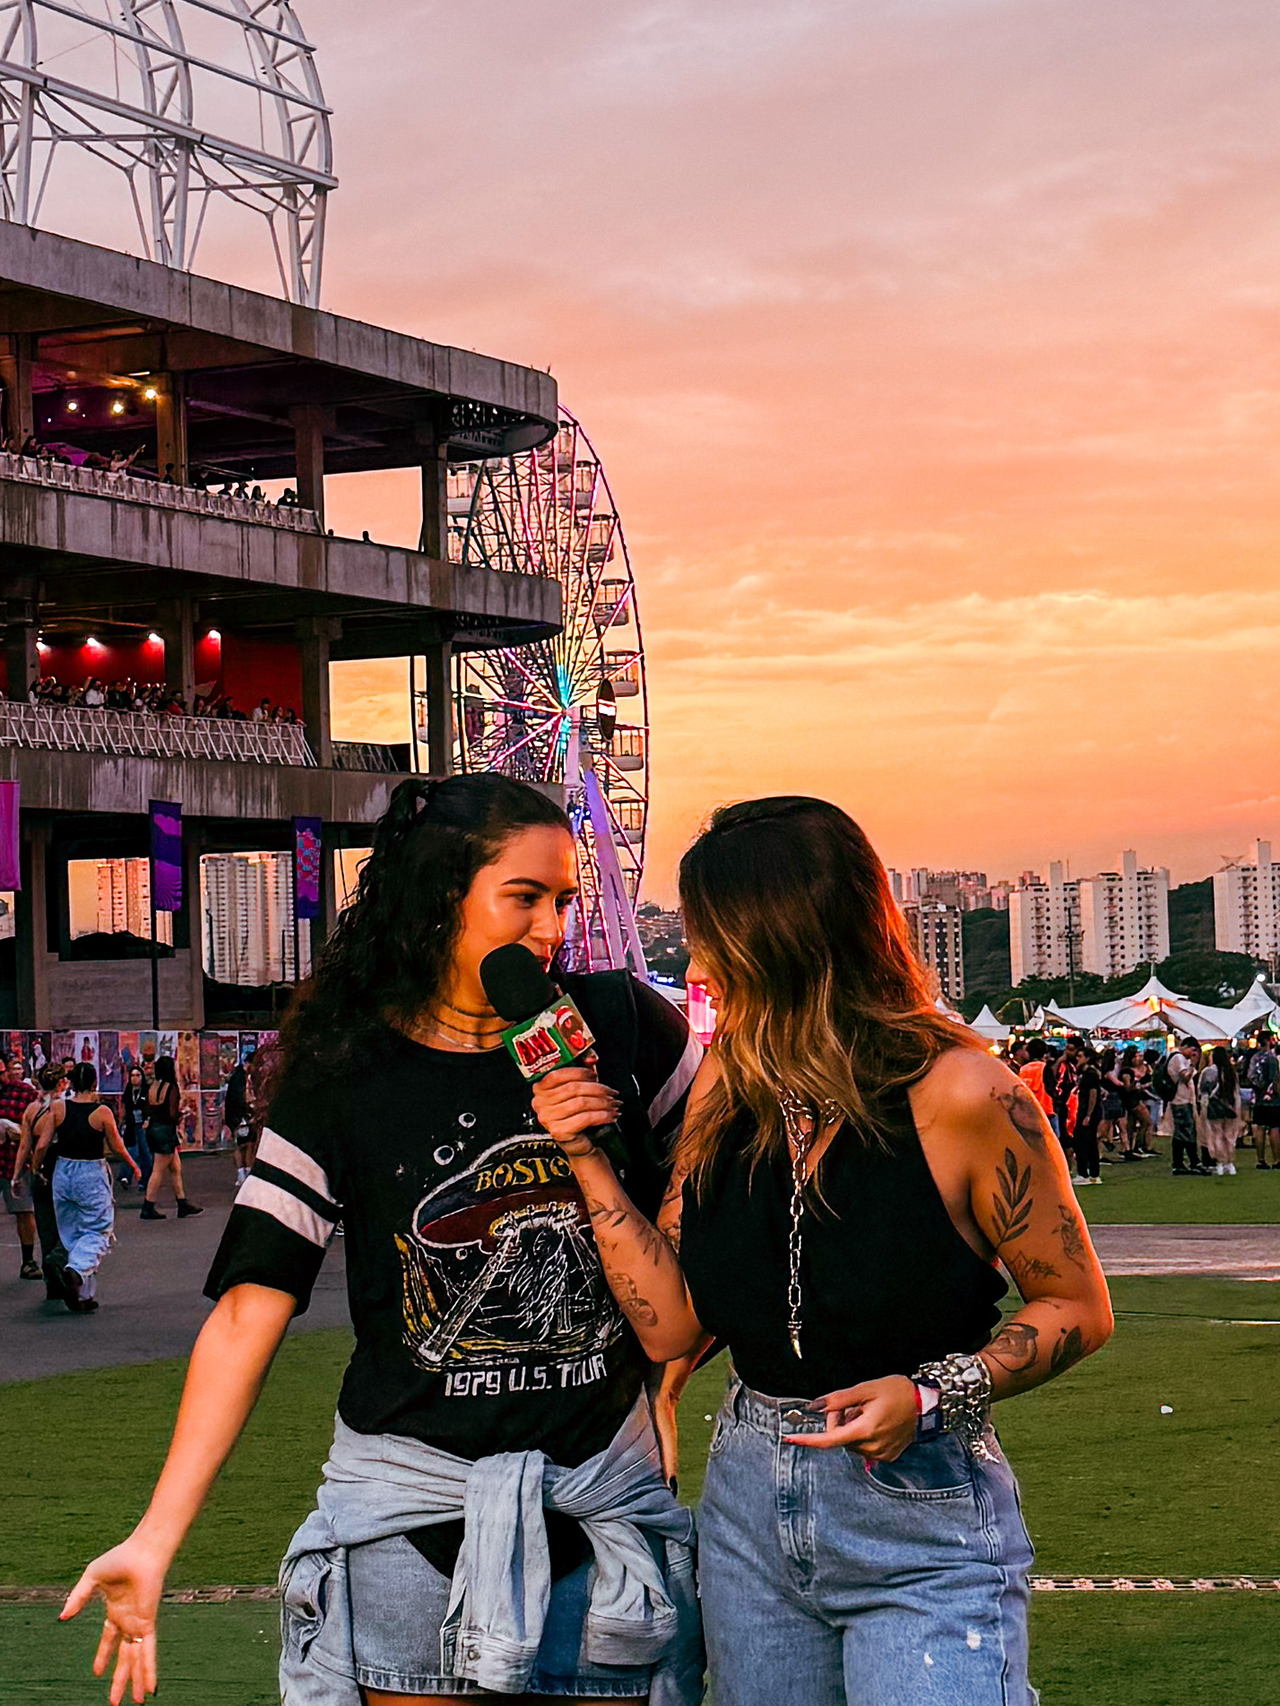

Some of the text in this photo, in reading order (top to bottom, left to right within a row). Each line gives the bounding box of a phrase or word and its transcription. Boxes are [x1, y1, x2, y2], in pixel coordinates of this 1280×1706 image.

[475, 1155, 572, 1192] BOSTO
[444, 1353, 608, 1396] 1979 U.S. TOUR
